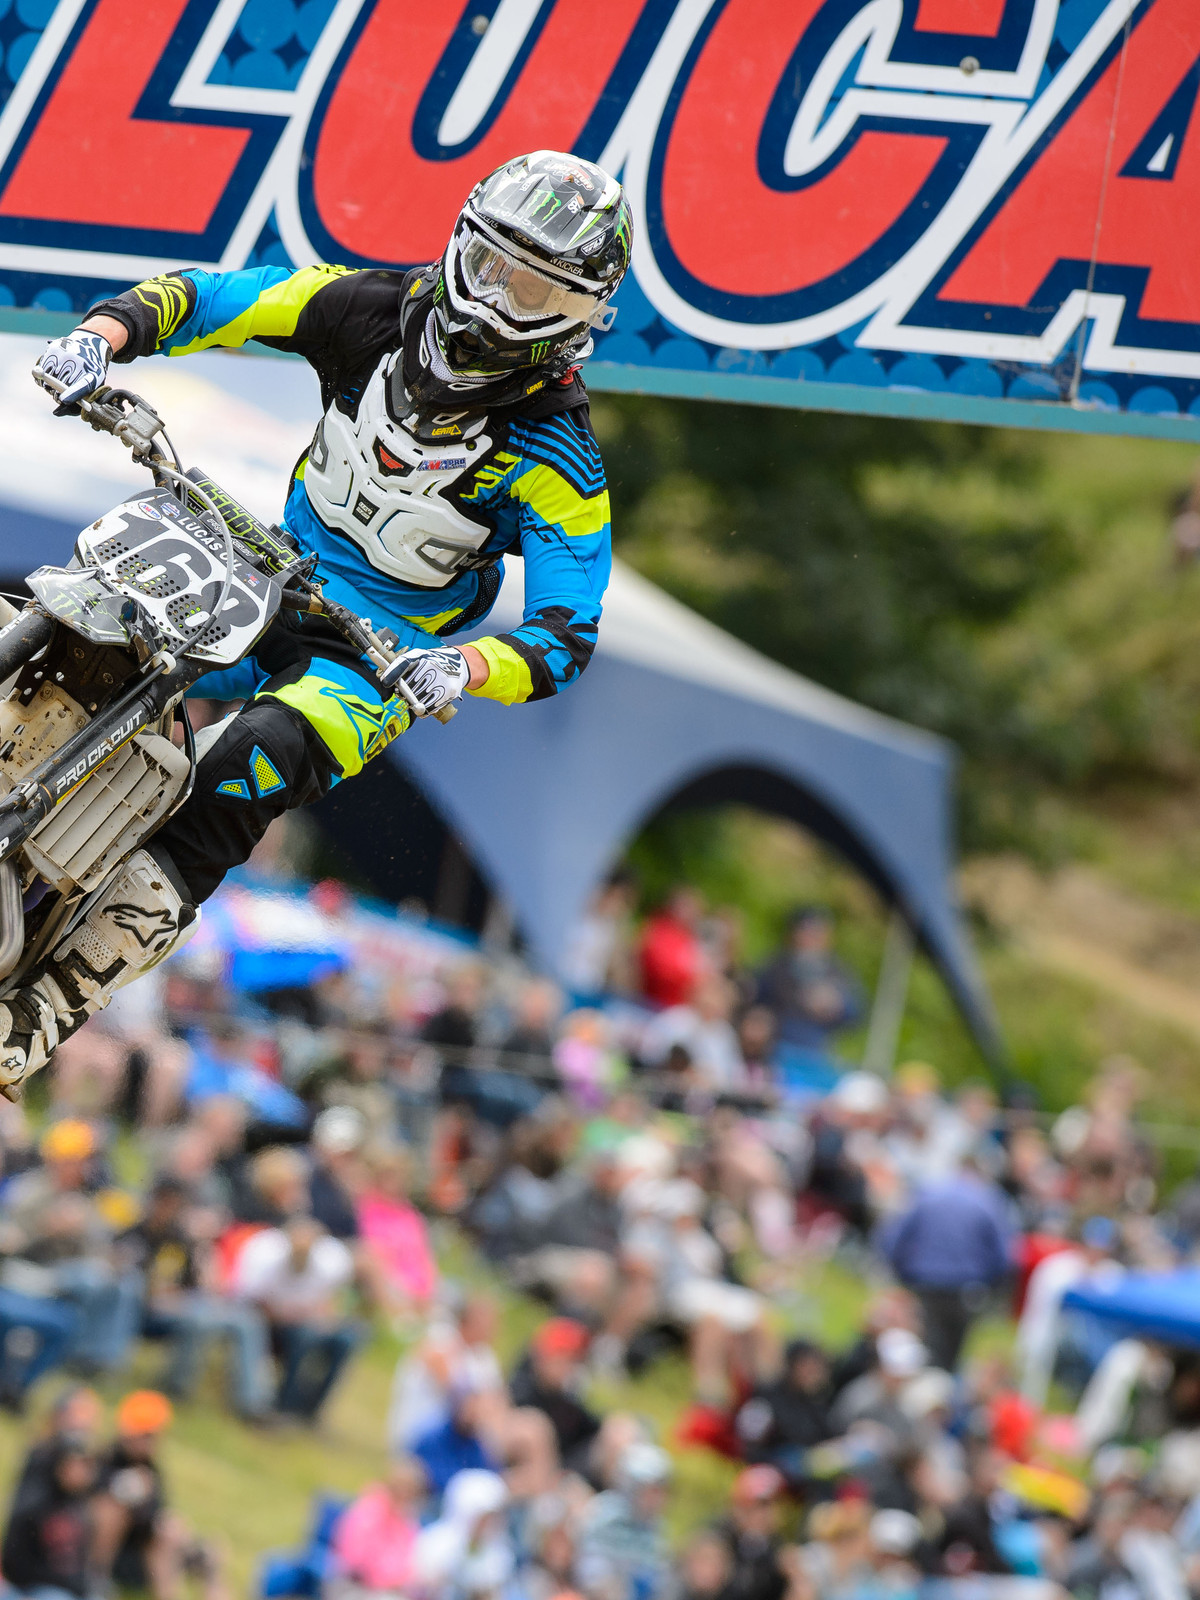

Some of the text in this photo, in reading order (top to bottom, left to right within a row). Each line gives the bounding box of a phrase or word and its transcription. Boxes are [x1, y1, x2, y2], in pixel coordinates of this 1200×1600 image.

[485, 205, 557, 250] MONSTER
[556, 258, 585, 277] KICKER
[176, 516, 223, 551] LUCAS
[85, 512, 260, 649] 168
[56, 710, 143, 795] PRO CIRCUIT
